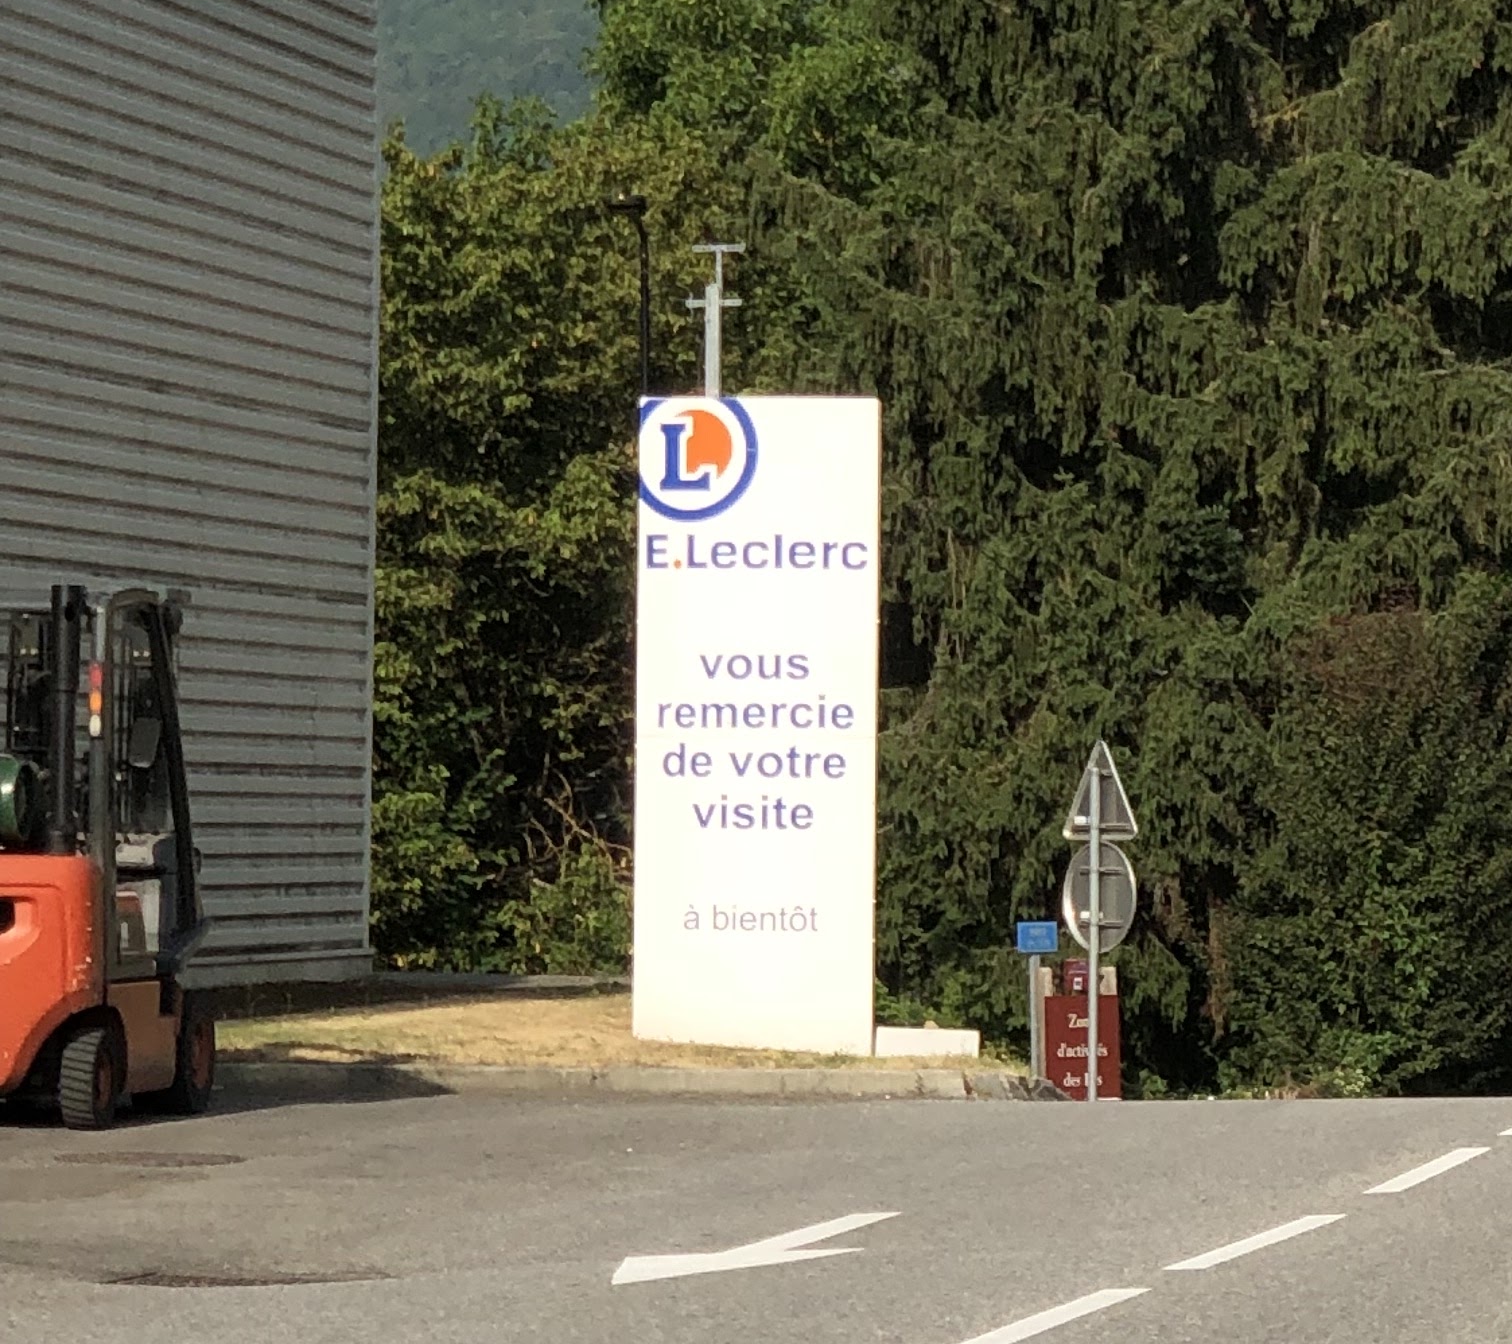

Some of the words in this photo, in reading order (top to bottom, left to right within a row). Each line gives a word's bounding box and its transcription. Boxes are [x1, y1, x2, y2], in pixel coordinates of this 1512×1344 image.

[645, 533, 868, 570] E.Leclerc
[699, 654, 810, 680] vous
[657, 694, 855, 730] remercie
[662, 742, 713, 778] de
[728, 745, 847, 779] votre
[692, 794, 814, 830] visite
[683, 904, 700, 930] à
[712, 903, 818, 932] bientôt
